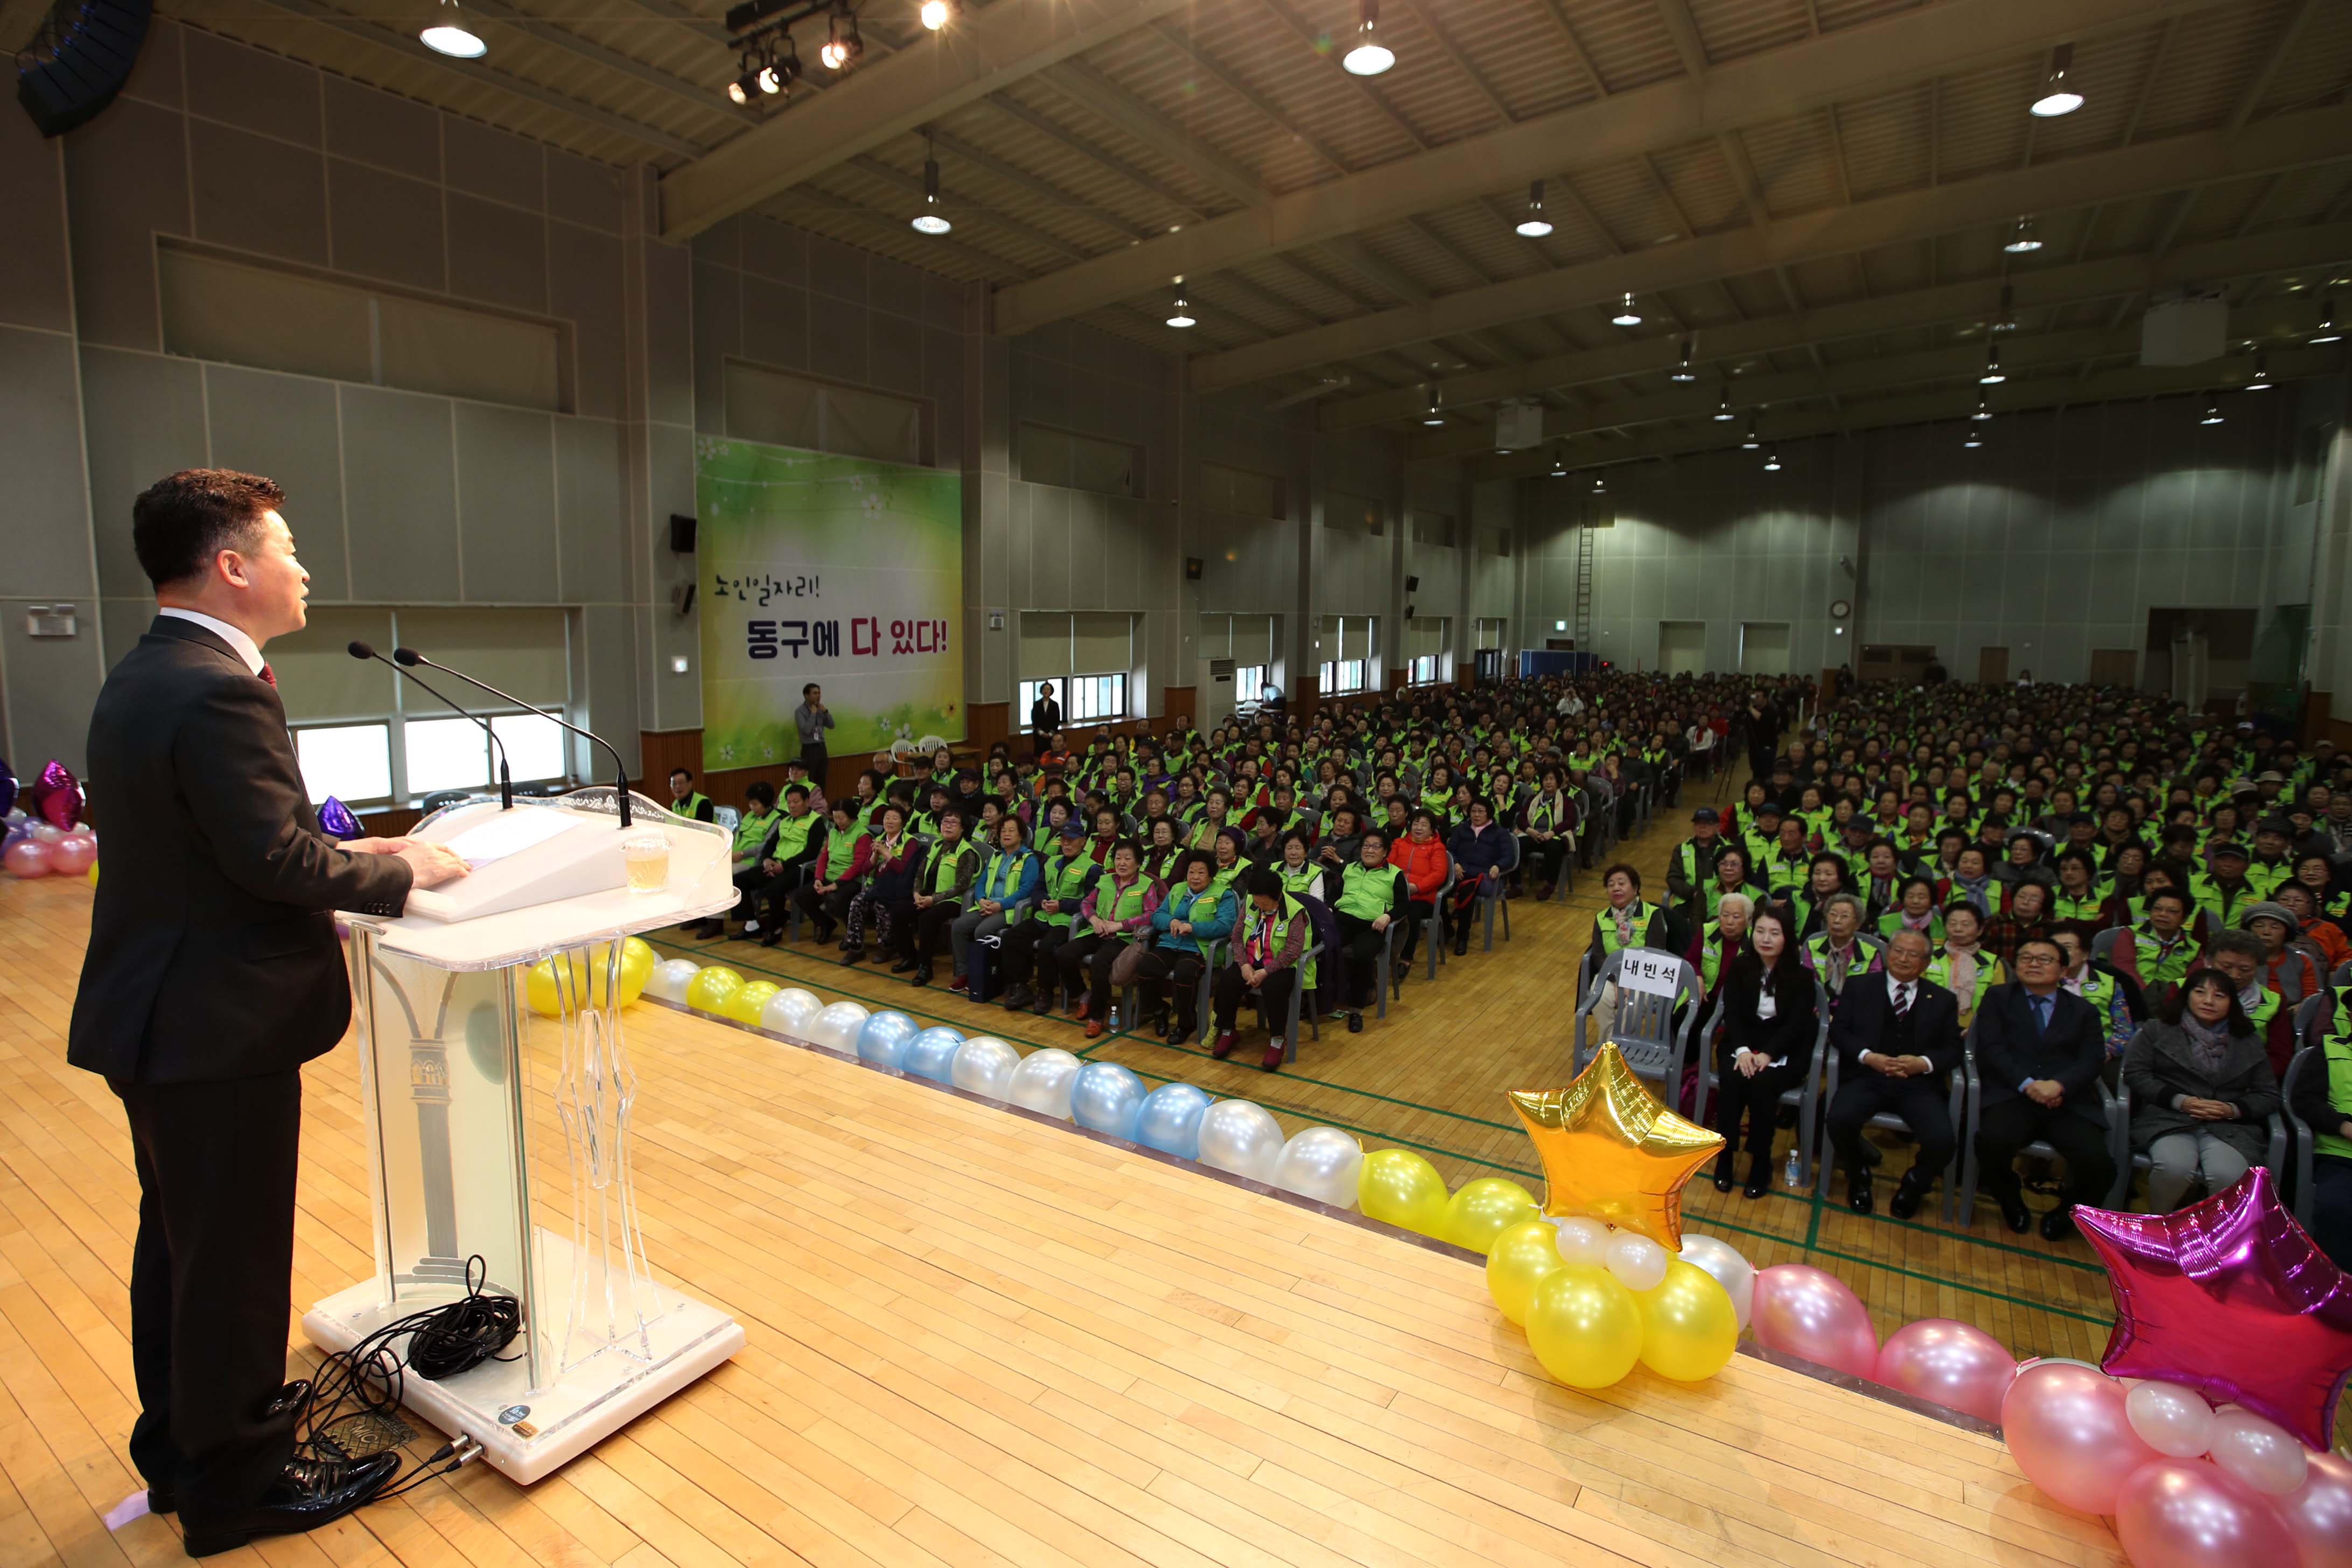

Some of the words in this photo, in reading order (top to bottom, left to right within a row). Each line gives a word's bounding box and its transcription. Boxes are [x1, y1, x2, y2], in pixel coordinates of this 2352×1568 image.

[715, 575, 820, 606] 노인일자리!
[747, 620, 839, 659] 동구에
[851, 617, 881, 656] 다
[891, 620, 947, 656] 있다!
[1625, 960, 1675, 983] 내빈석
[351, 1425, 378, 1443] MIC
